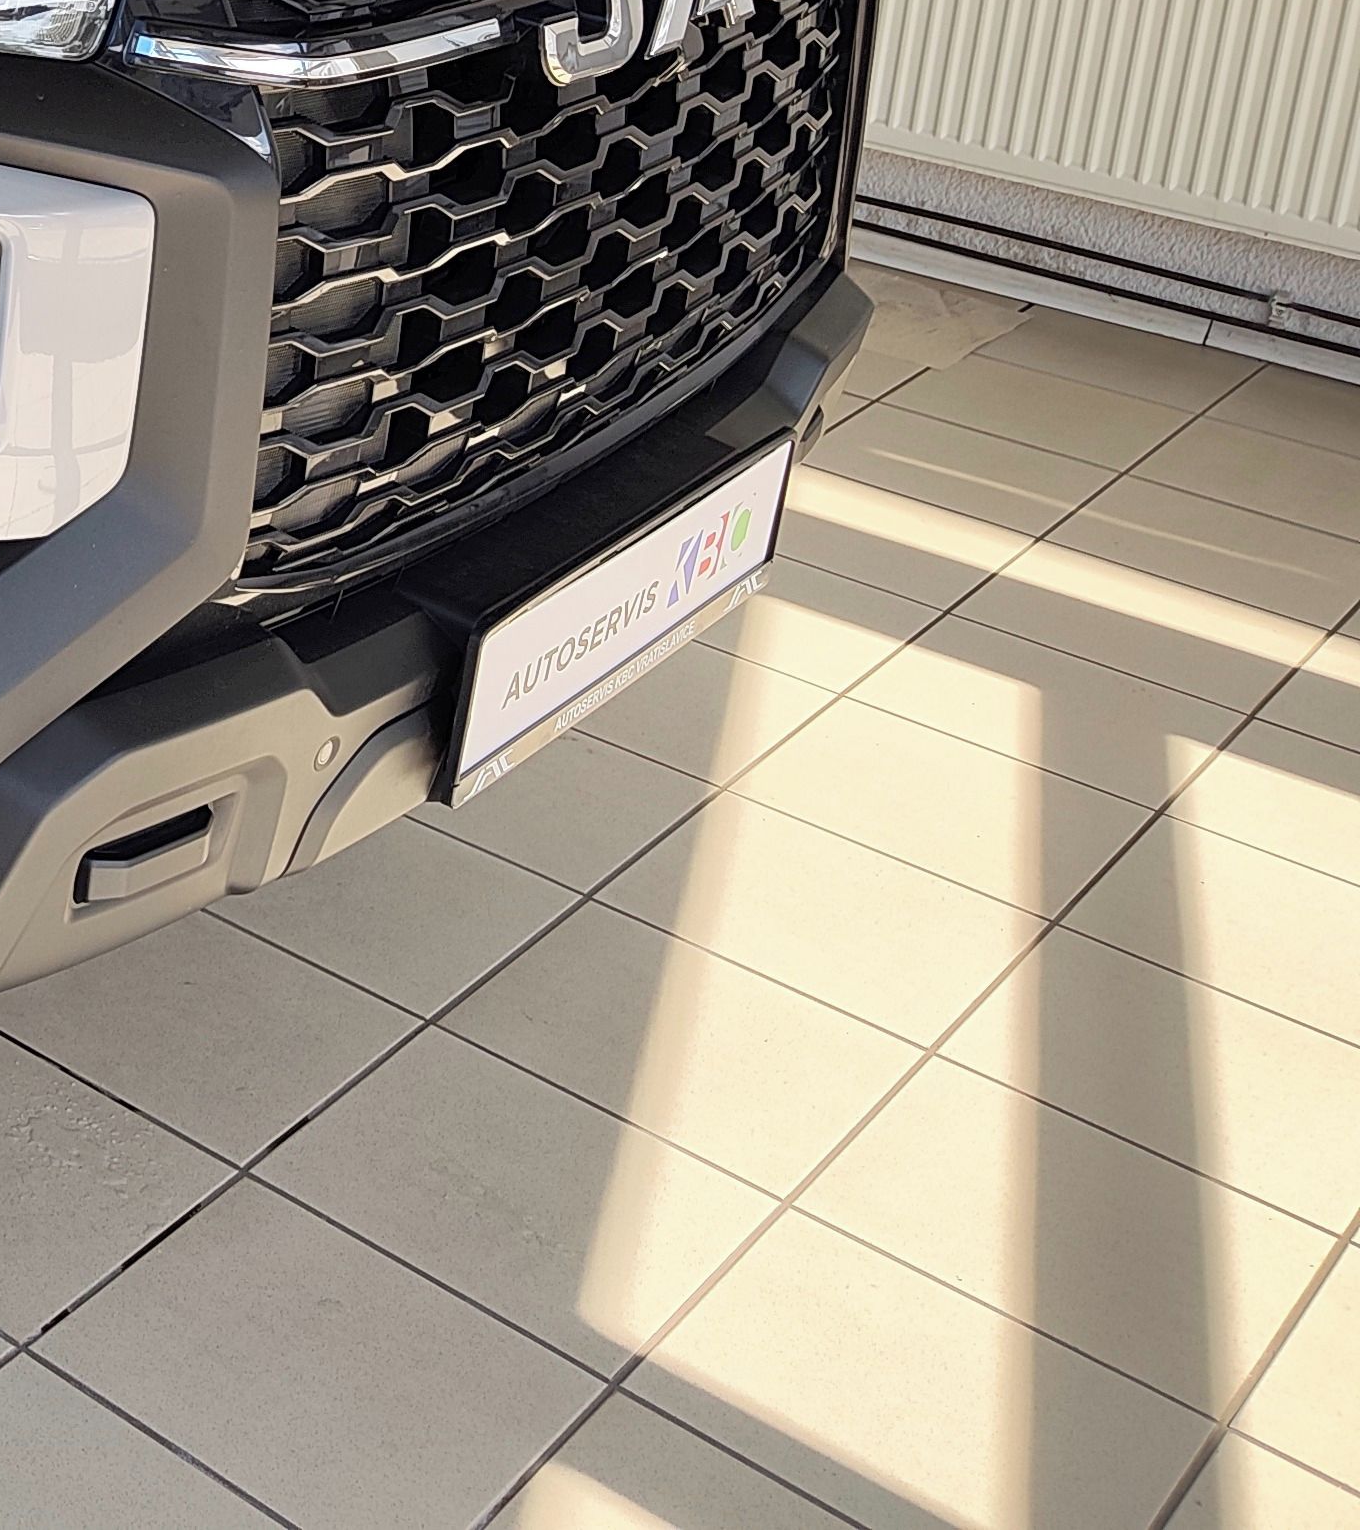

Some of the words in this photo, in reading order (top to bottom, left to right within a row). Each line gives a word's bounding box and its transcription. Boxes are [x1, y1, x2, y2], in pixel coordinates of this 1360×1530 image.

[501, 580, 659, 710] AUTOSERVIS
[554, 678, 615, 732] AUTOSERVIS
[614, 665, 635, 689] KBC
[636, 620, 696, 675] VRATISLAVICE
